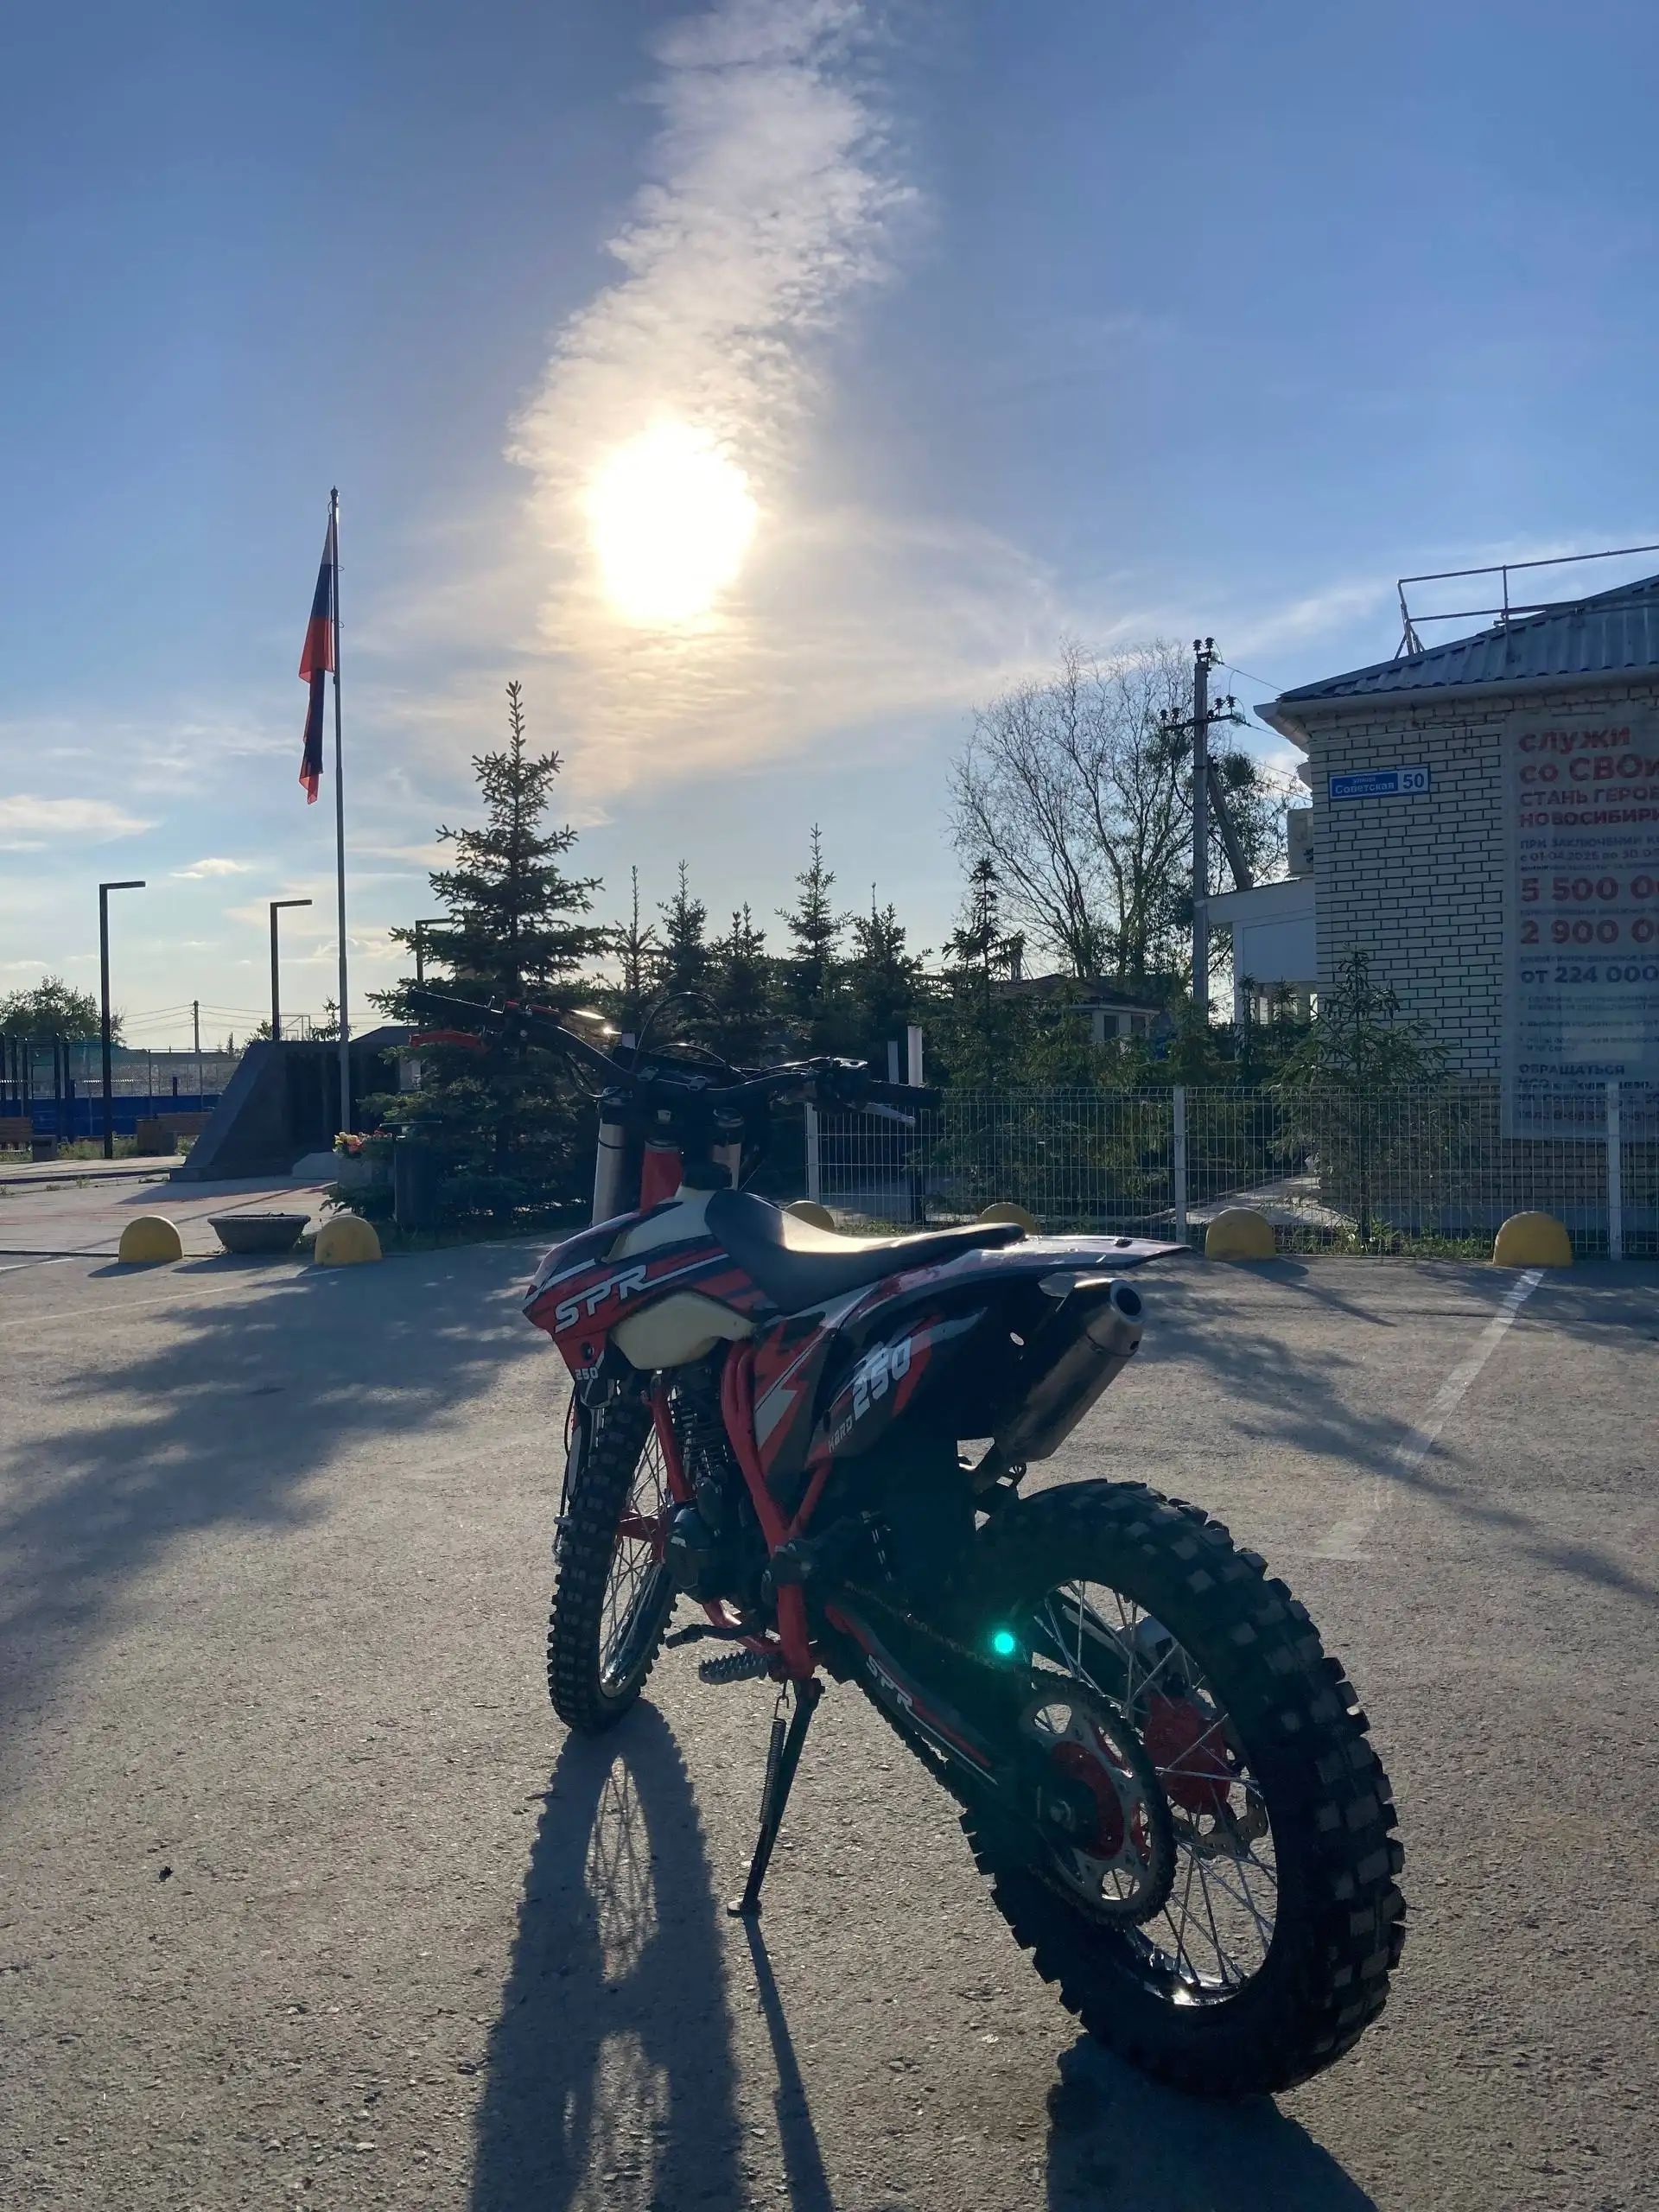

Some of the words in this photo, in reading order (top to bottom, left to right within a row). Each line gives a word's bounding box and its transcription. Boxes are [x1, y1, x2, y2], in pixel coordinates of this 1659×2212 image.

[1335, 782, 1395, 794] Советская
[1402, 772, 1425, 790] 50
[1520, 789, 1588, 806] СТАНЬ
[1520, 838, 1548, 849] ПРИ
[1521, 877, 1541, 902] 5
[1551, 875, 1619, 902] 500
[1520, 919, 1540, 944] 2
[1550, 918, 1619, 944] 900
[1521, 969, 1548, 984] от
[1554, 965, 1599, 983] 224
[1605, 964, 1659, 983] 000
[1518, 1063, 1625, 1076] ОБРАЩАТЬСЯ
[555, 1264, 648, 1334] SPR
[575, 1368, 600, 1382] 250
[852, 1338, 912, 1421] 250
